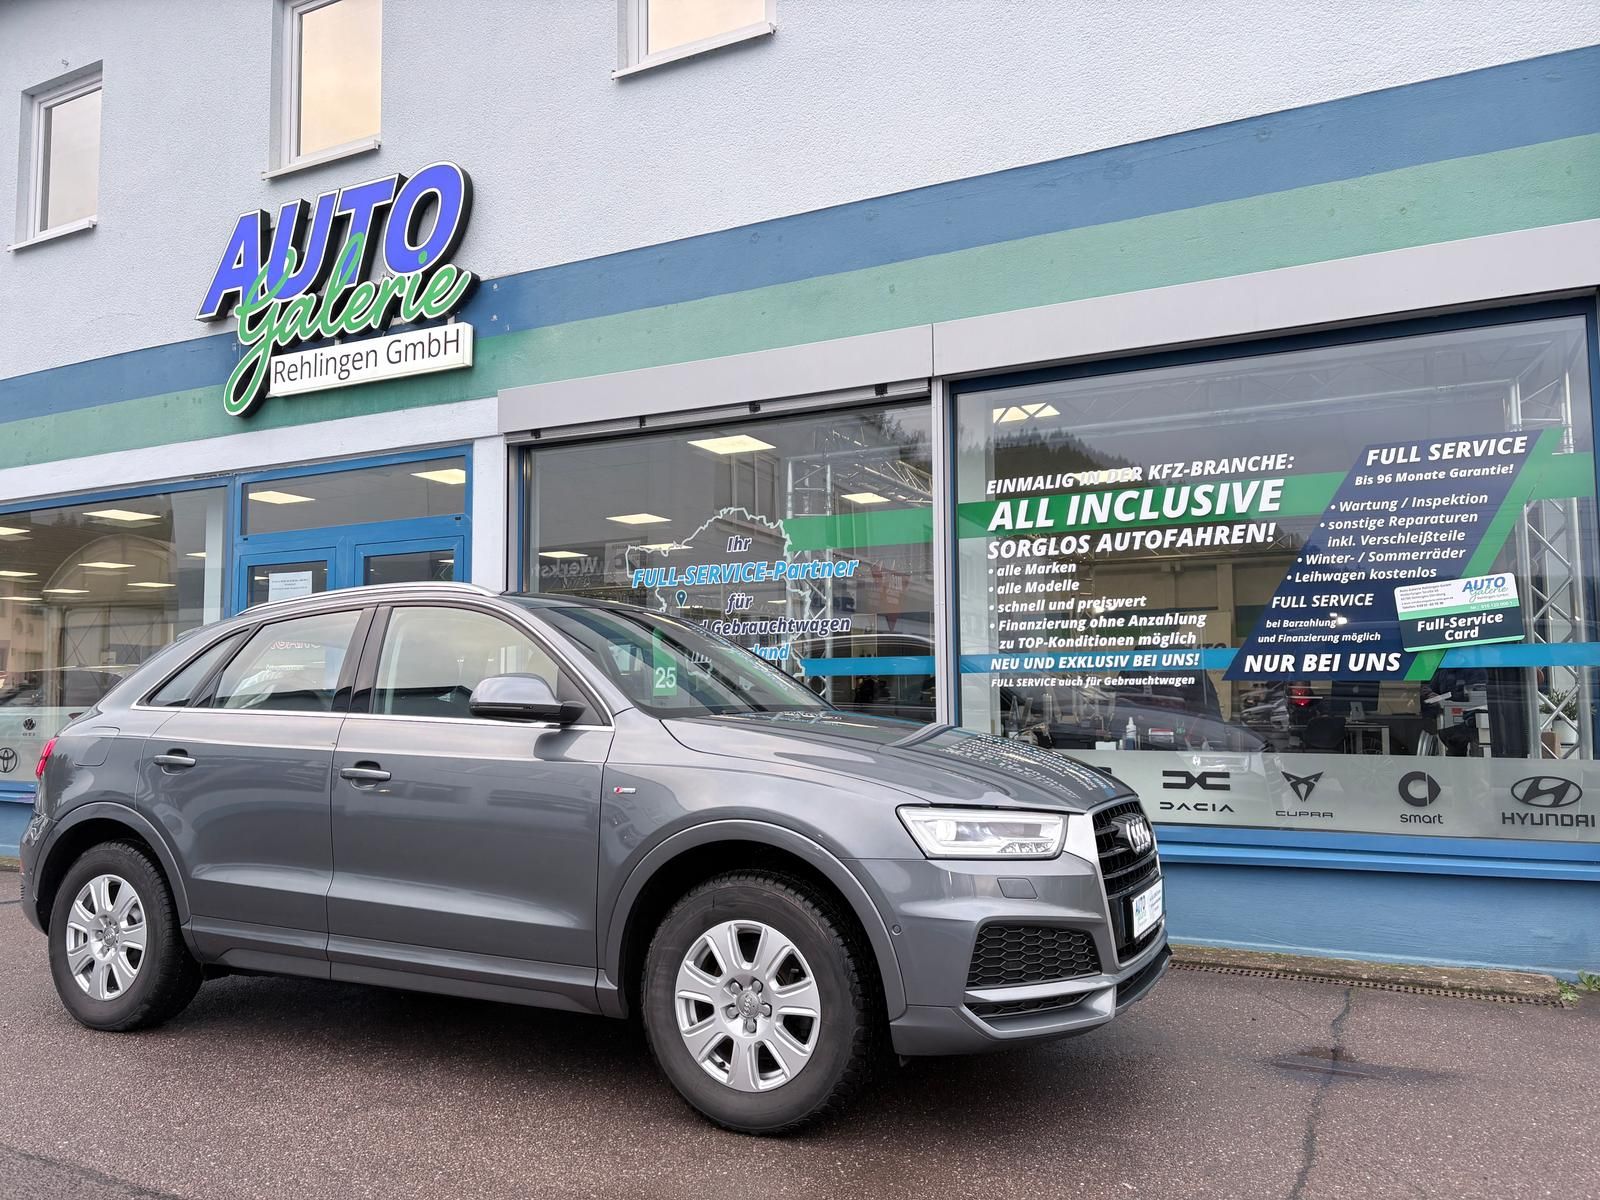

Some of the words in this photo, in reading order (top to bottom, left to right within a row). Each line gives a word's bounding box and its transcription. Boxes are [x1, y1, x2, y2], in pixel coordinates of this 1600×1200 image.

[195, 161, 466, 320] AUTO
[223, 232, 472, 417] Galerie
[273, 347, 378, 384] Rehlingen
[386, 329, 460, 365] GmbH
[1366, 446, 1421, 466] FULL
[1427, 436, 1528, 462] SERVICE
[986, 476, 1074, 495] EINMALIG
[1079, 472, 1102, 487] IN
[1107, 466, 1143, 483] DER
[1148, 453, 1295, 480] KFZ-BRANCHE:
[1355, 475, 1373, 486] Bis
[1376, 473, 1393, 484] 96
[1395, 469, 1446, 483] Monate
[1449, 464, 1514, 479] Garantie!
[987, 497, 1055, 532] ALL
[1066, 478, 1285, 525] INCLUSIVE
[1339, 498, 1398, 515] Wartung
[1411, 492, 1489, 511] Inspektion
[1328, 516, 1385, 533] sonstige
[1388, 511, 1478, 531] Reparaturen
[726, 535, 752, 553] Ihr
[987, 535, 1090, 560] SORGLOS
[1095, 522, 1277, 553] AUTOFAHREN!
[1327, 535, 1356, 547] inkl.
[1360, 530, 1466, 548] Verschleißteile
[1306, 552, 1355, 565] Winter-
[1368, 547, 1466, 563] Sommerräder
[631, 558, 859, 590] FULL-SERVICE-Partner
[997, 565, 1021, 577] alle
[1024, 562, 1077, 575] Marken
[1295, 569, 1366, 585] Leihwagen
[1369, 566, 1437, 581] kostenlos
[997, 583, 1022, 595] alle
[1025, 580, 1080, 594] Modelle
[1462, 576, 1506, 593] AUTO
[725, 593, 753, 614] für
[997, 600, 1045, 613] schnell
[1048, 598, 1074, 611] und
[1077, 595, 1147, 613] preiswert
[1272, 596, 1308, 609] FULL
[1312, 593, 1374, 608] SERVICE
[710, 616, 852, 636] Gebrauchtwagen
[998, 616, 1087, 635] Finanzierung
[1089, 616, 1125, 629] ohne
[1128, 612, 1207, 632] Anzahlung
[1266, 618, 1281, 629] bei
[1283, 617, 1337, 630] Barzahlung
[1417, 613, 1504, 632] Full-Service
[999, 639, 1015, 650] zu
[1018, 635, 1135, 649] TOP-Konditionen
[1138, 631, 1197, 651] möglich
[1257, 634, 1276, 643] und
[1278, 632, 1340, 645] Finanzierung
[1342, 631, 1381, 644] möglich
[1444, 626, 1479, 641] Card
[750, 643, 790, 660] land
[991, 658, 1020, 670] NEU
[1023, 657, 1055, 669] UND
[1058, 655, 1131, 669] EXKLUSIV
[1132, 654, 1158, 667] BEI
[1161, 653, 1200, 667] UNS!
[1244, 654, 1296, 673] NUR
[1302, 654, 1343, 672] BEI
[1348, 652, 1401, 672] UNS
[655, 667, 676, 688] 25
[991, 678, 1014, 688] FULL
[1016, 677, 1057, 687] SERVICE
[1059, 676, 1083, 686] auch
[1085, 675, 1102, 689] für
[1103, 675, 1195, 688] Gebrauchtwagen
[1159, 801, 1235, 813] DACIA
[1275, 810, 1334, 818] CUPRA
[1400, 813, 1444, 825] smart
[1501, 812, 1596, 827] HYUNDAI
